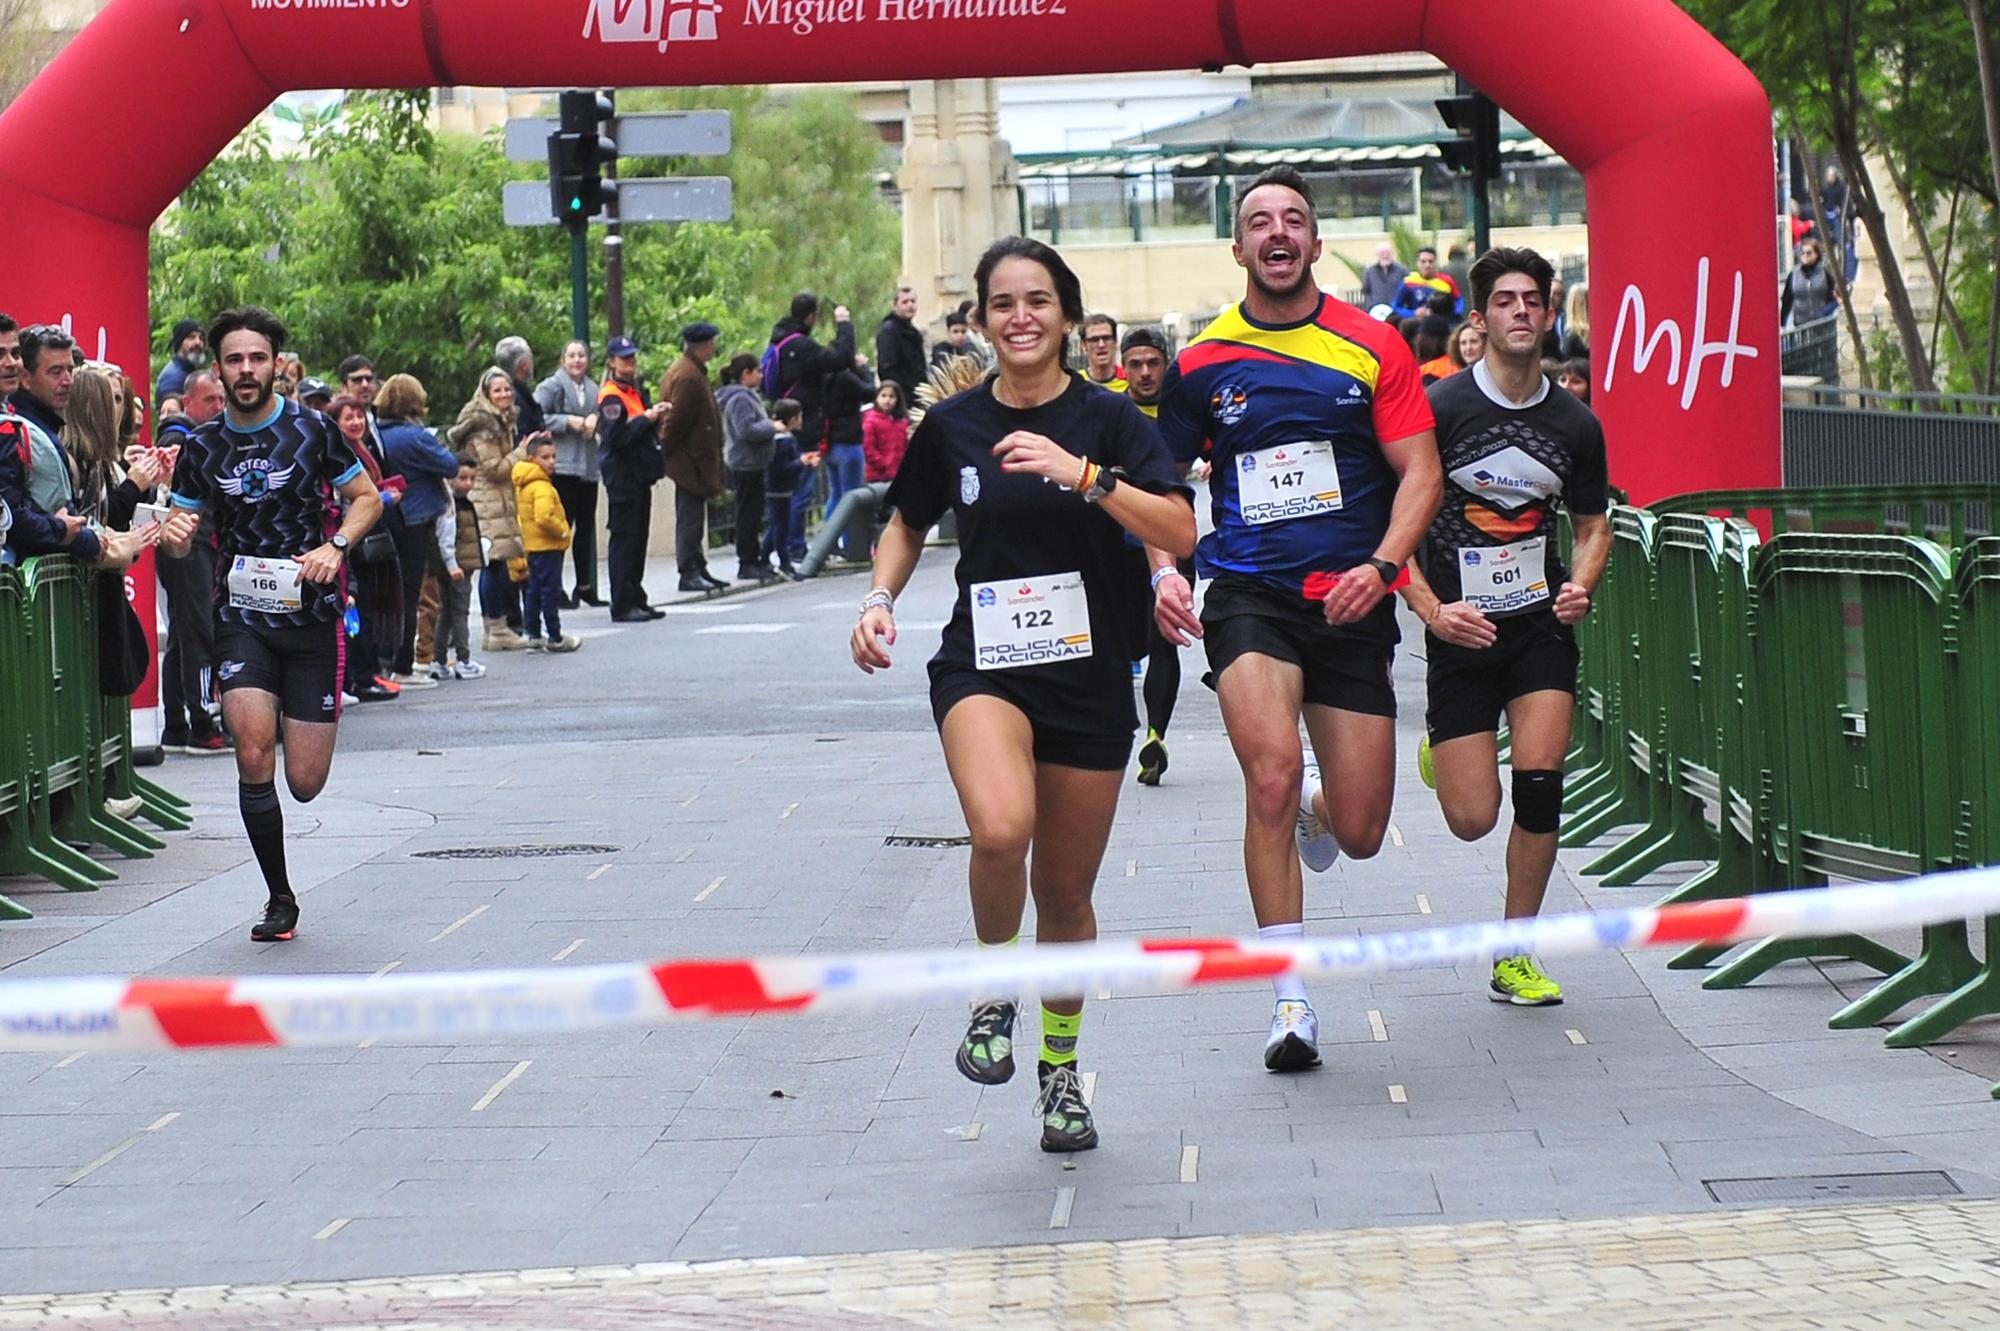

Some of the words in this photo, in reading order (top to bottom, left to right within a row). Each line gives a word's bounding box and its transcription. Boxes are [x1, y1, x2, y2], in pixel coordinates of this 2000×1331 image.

[1270, 471, 1304, 489] 147
[1243, 495, 1319, 514] POLICIA
[1245, 501, 1341, 522] NACIONAL
[251, 578, 277, 591] 166
[1492, 566, 1521, 585] 601
[231, 592, 284, 605] POLICIA
[1465, 587, 1532, 602] POLICIA
[1011, 609, 1054, 629] 122
[979, 638, 1067, 655] POLICIA
[980, 645, 1091, 666] NACIONAL
